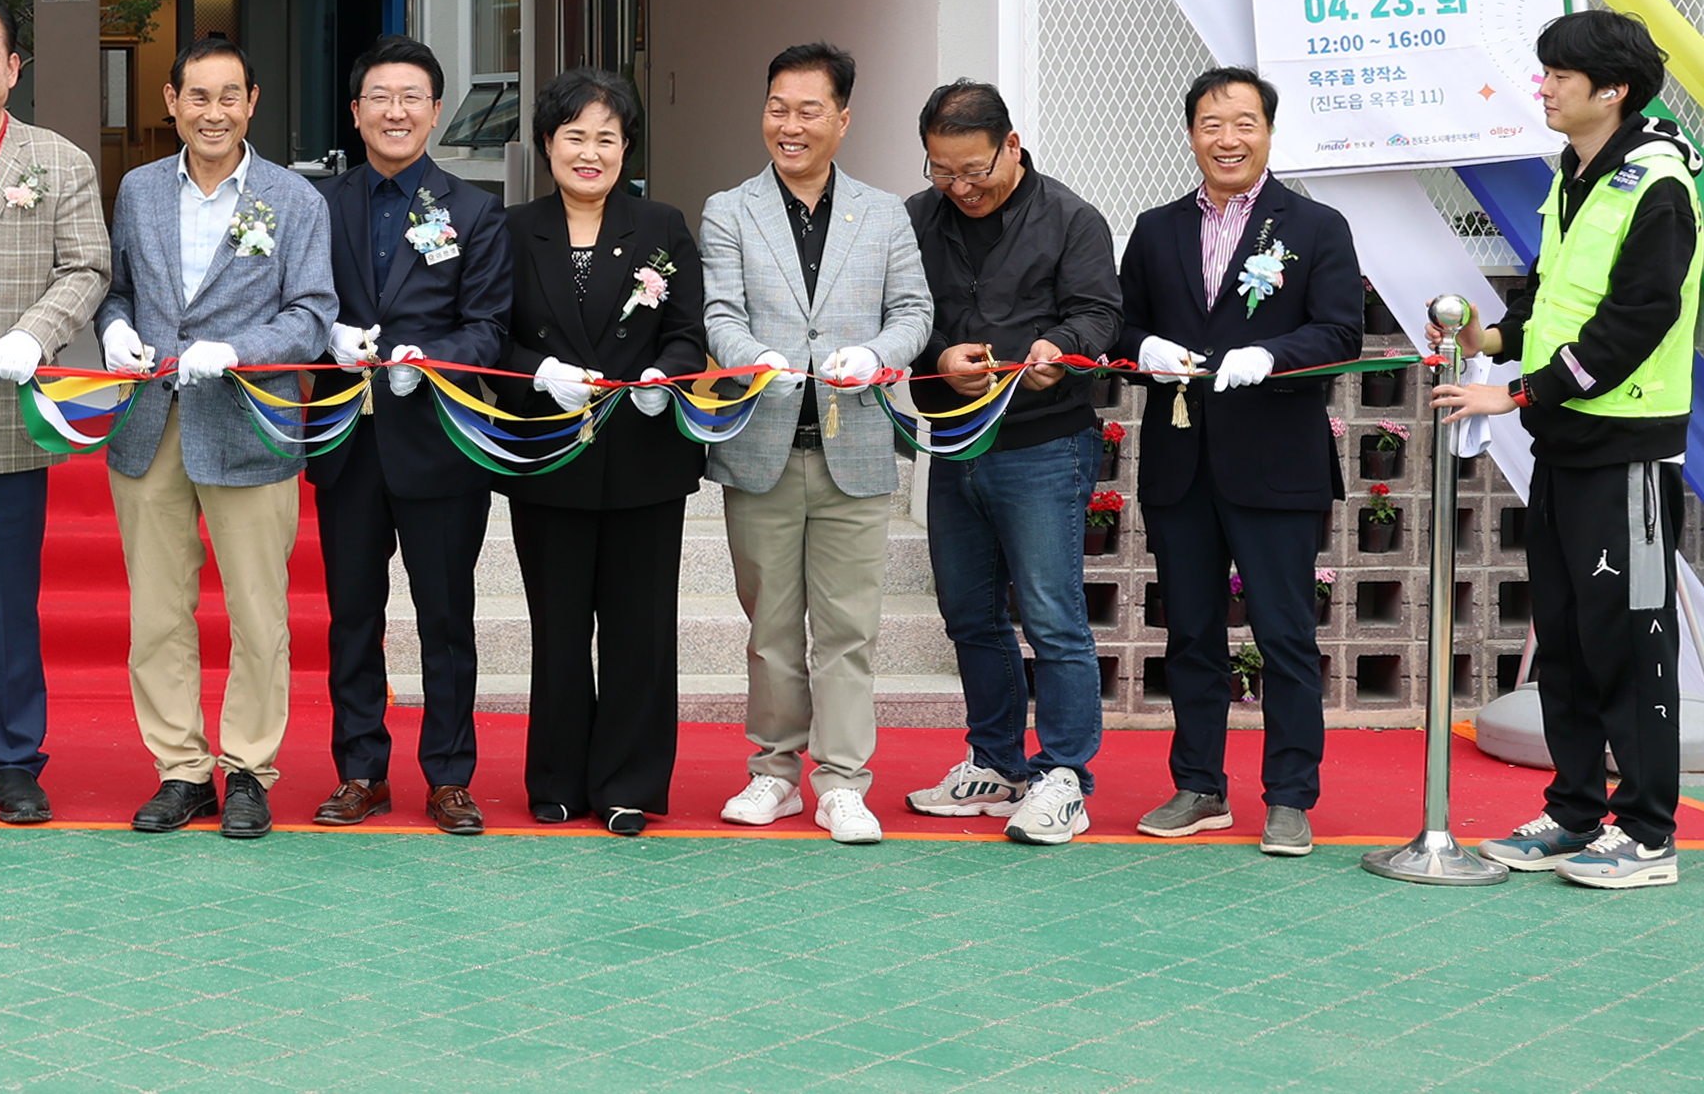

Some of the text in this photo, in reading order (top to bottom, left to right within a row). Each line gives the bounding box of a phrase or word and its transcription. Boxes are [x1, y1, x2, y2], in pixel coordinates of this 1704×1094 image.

[1307, 35, 1364, 55] 12:00
[1388, 29, 1446, 49] 16:00
[1308, 66, 1407, 87] 옥주골 창작소
[1310, 88, 1445, 114] (진도읍 옥주길 11)
